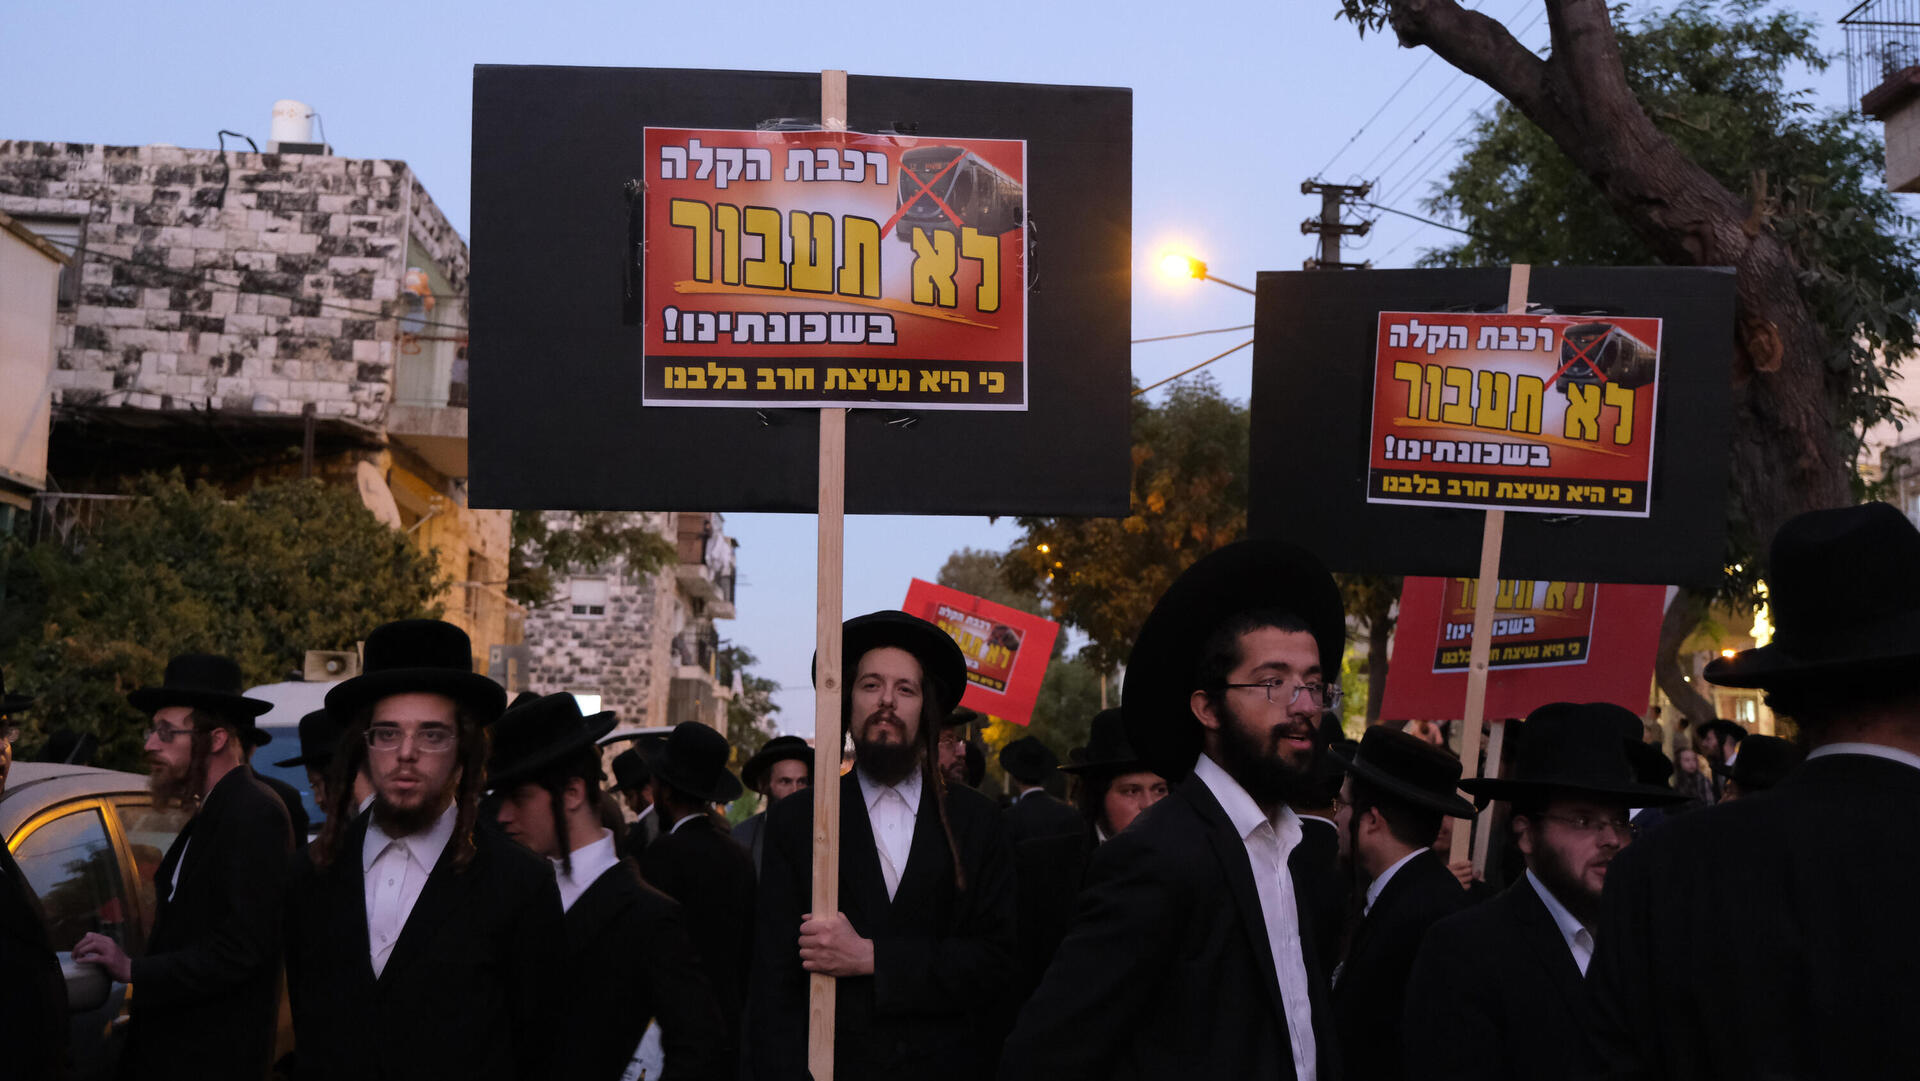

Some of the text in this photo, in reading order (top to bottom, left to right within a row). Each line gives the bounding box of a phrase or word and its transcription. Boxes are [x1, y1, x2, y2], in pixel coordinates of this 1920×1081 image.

[660, 138, 889, 190] רכבת הקלה
[669, 197, 1001, 313] לא תעבור
[662, 305, 898, 346] בשכונתינו!
[1388, 318, 1554, 356] רכבת הקלה
[663, 362, 1005, 394] כי היא נעיצת חרב בלבנו
[1392, 360, 1636, 446] לא תעבור
[1384, 434, 1552, 468] בשכונתינו!
[1381, 473, 1634, 505] כי היא נעיצת חרב בלבנו
[1445, 616, 1535, 640] בשכוינו!
[987, 643, 1010, 669] לא
[1542, 643, 1565, 658] היא
[1568, 642, 1580, 655] כי
